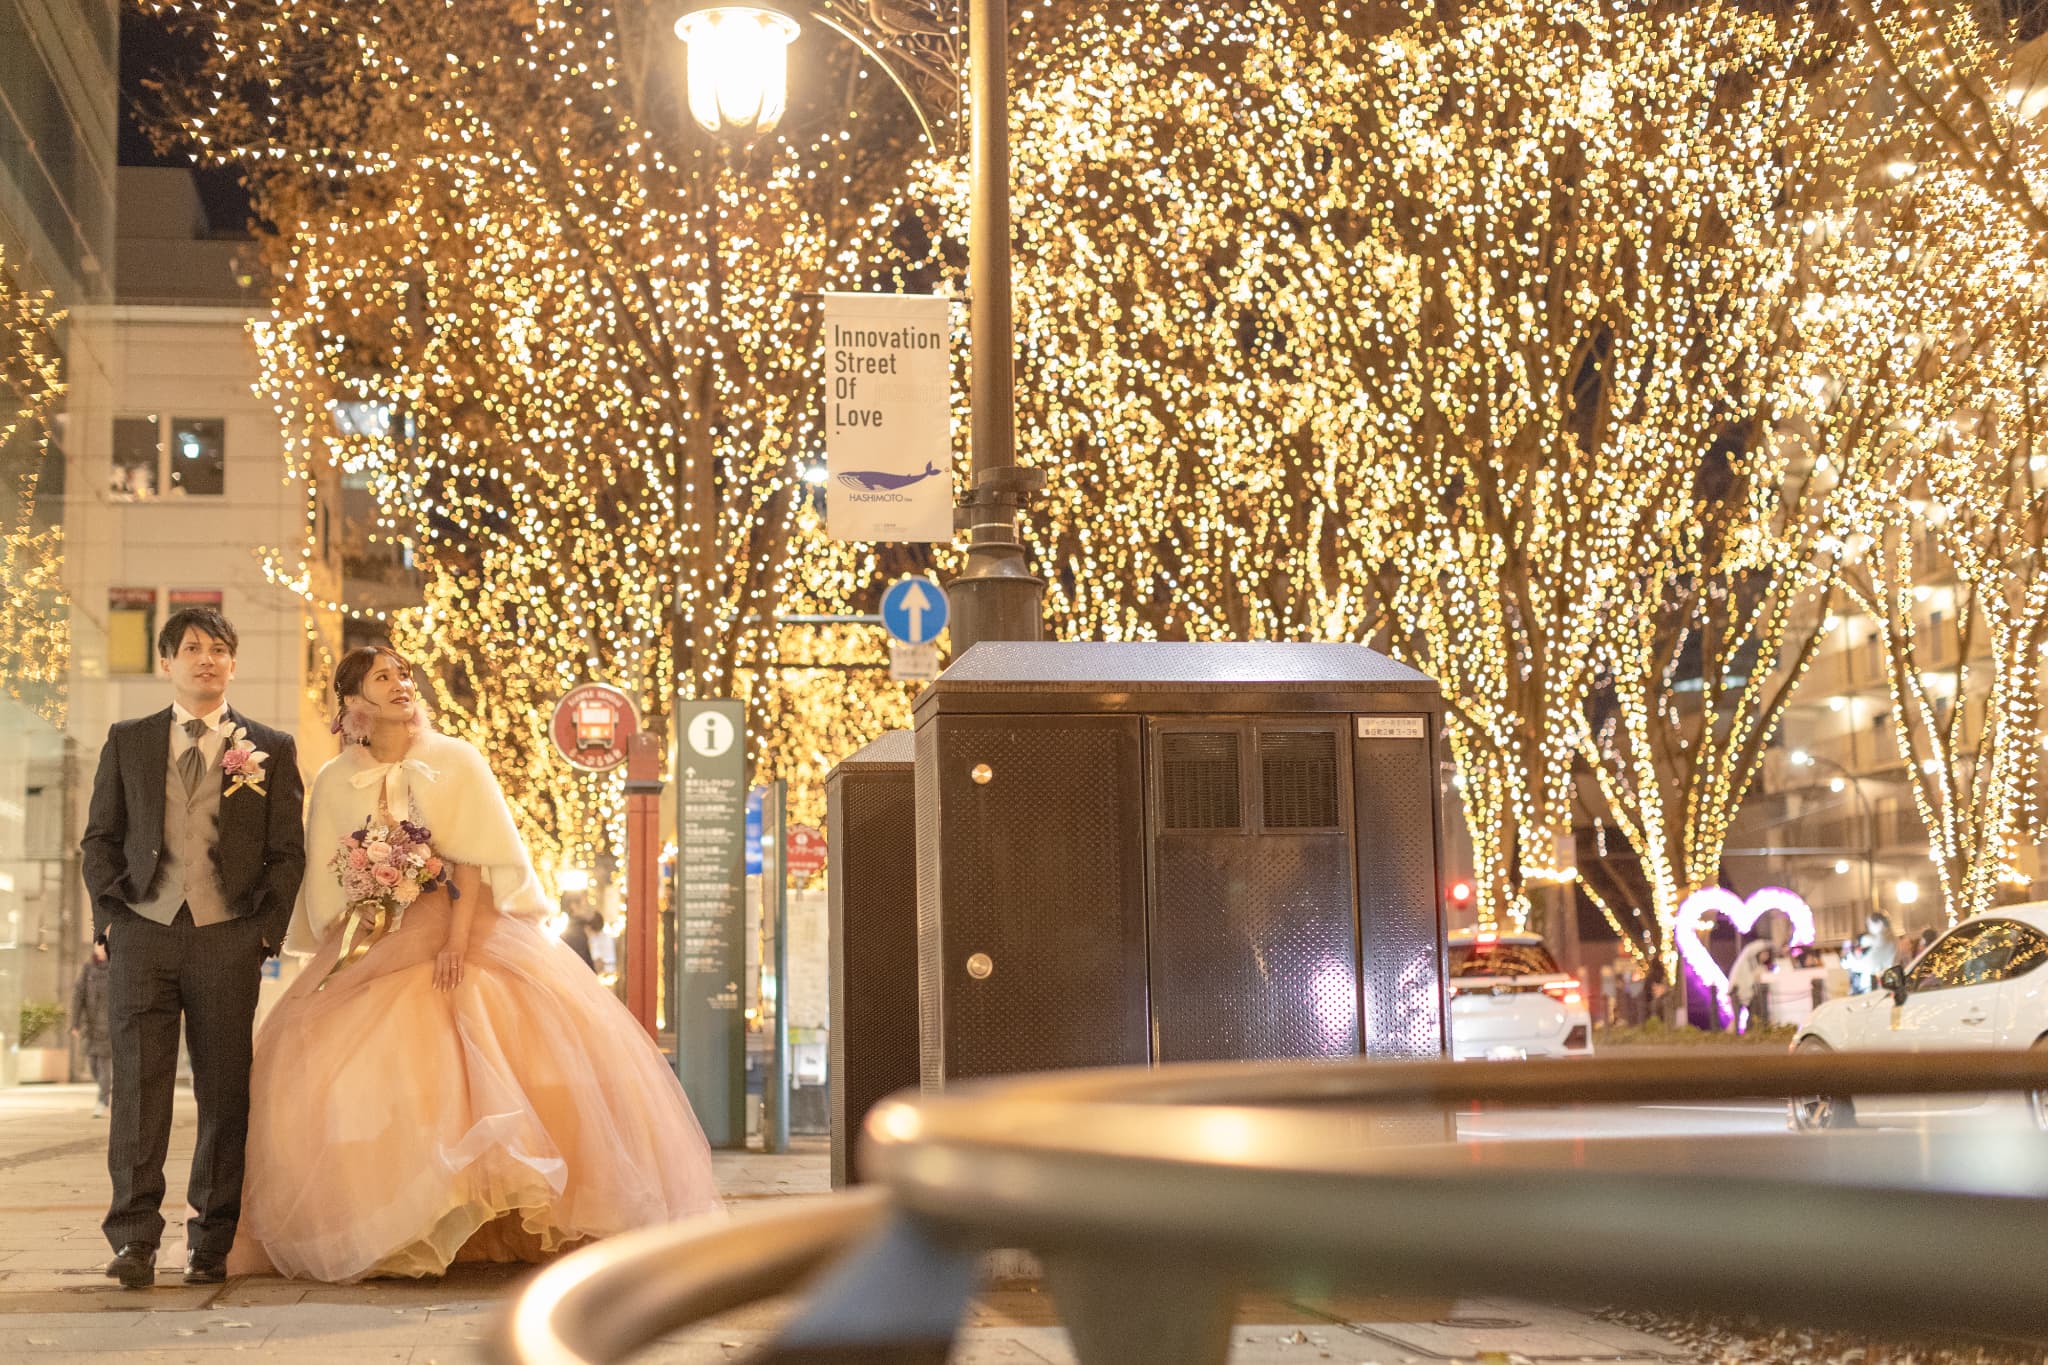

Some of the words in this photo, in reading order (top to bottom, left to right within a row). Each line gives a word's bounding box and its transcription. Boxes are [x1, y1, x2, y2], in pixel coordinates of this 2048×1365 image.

[835, 325, 940, 349] Innovation
[835, 350, 896, 374] Street
[836, 377, 857, 400] Of
[836, 403, 883, 427] Love
[849, 493, 903, 502] HASHIMOTO
